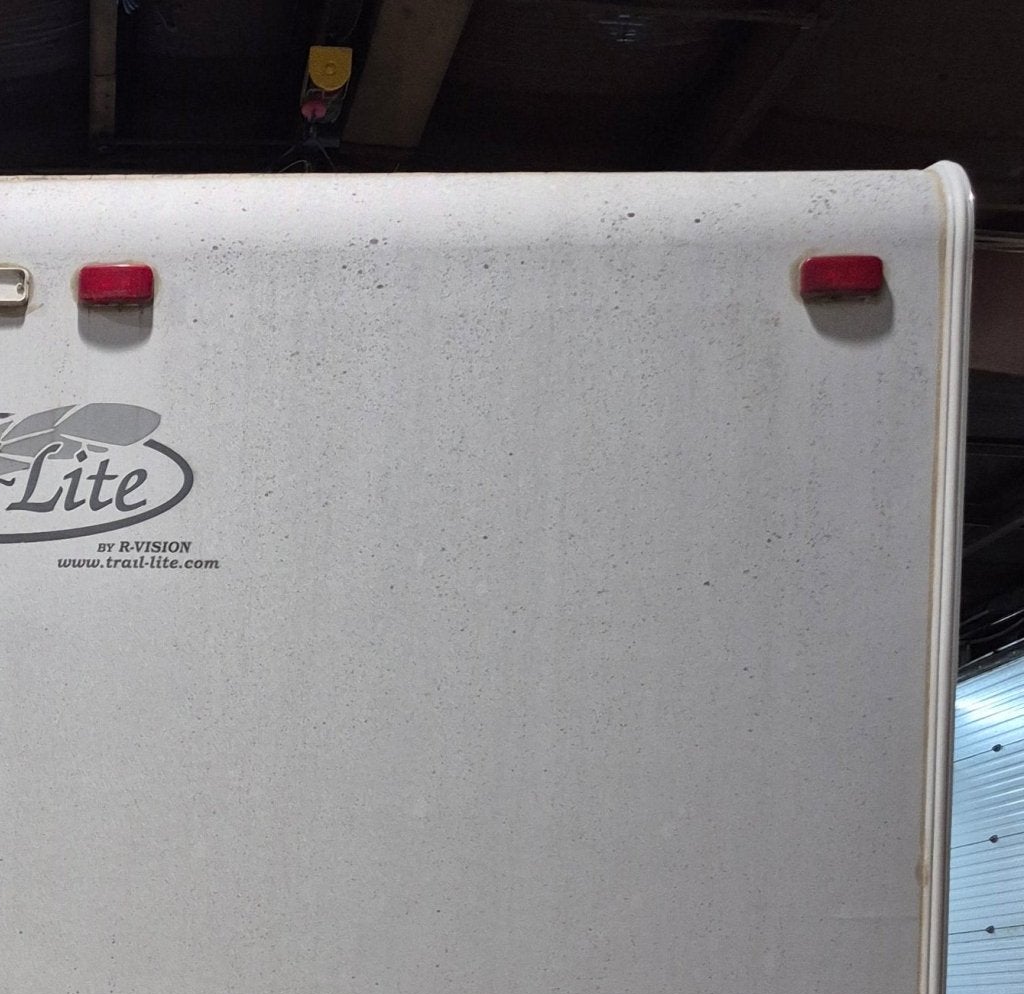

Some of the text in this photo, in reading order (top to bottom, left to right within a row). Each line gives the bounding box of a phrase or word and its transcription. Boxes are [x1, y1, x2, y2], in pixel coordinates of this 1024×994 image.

[97, 541, 192, 553] BY R-VISION
[57, 556, 220, 569] www.trail-lite.com
